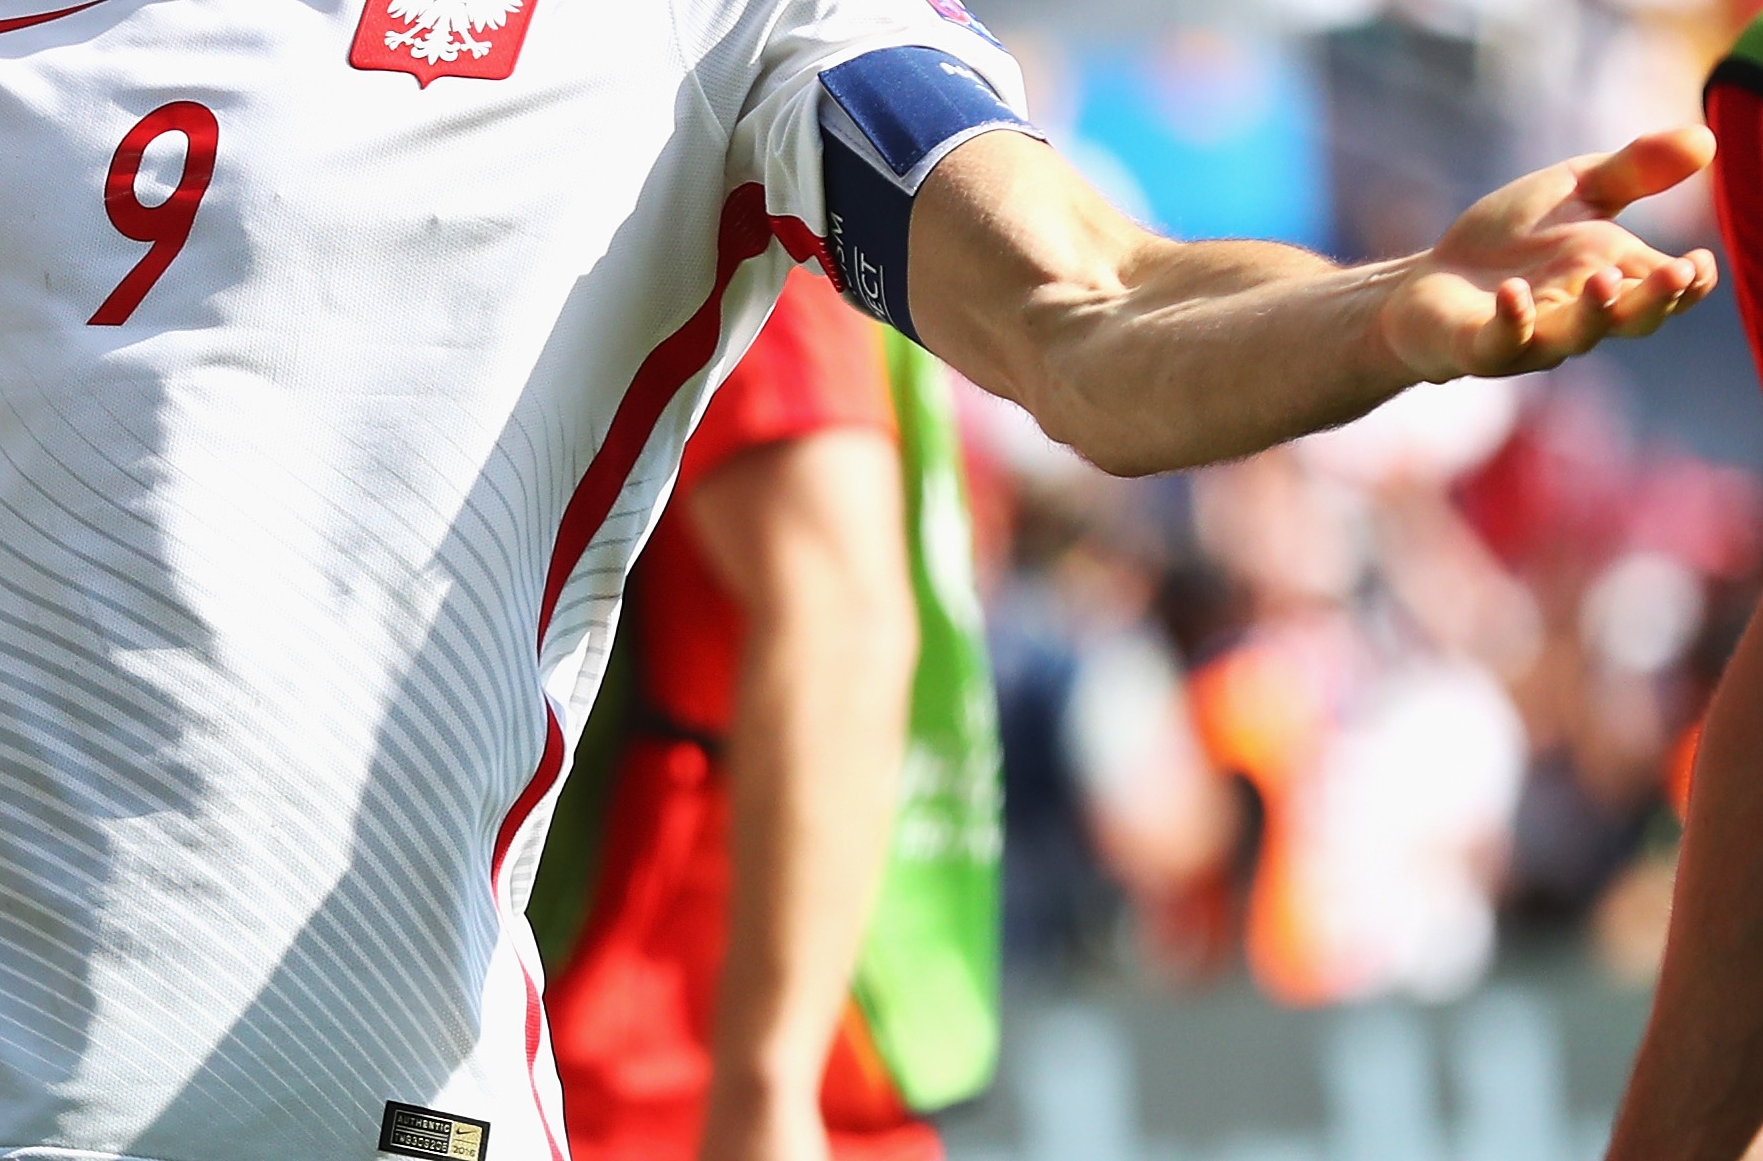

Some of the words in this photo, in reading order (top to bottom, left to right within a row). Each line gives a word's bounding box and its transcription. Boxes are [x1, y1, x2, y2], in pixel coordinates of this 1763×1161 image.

[86, 100, 219, 326] 9
[861, 252, 886, 322] ECT
[397, 1115, 450, 1133] AUTHENTIC
[453, 1145, 476, 1158] 2016
